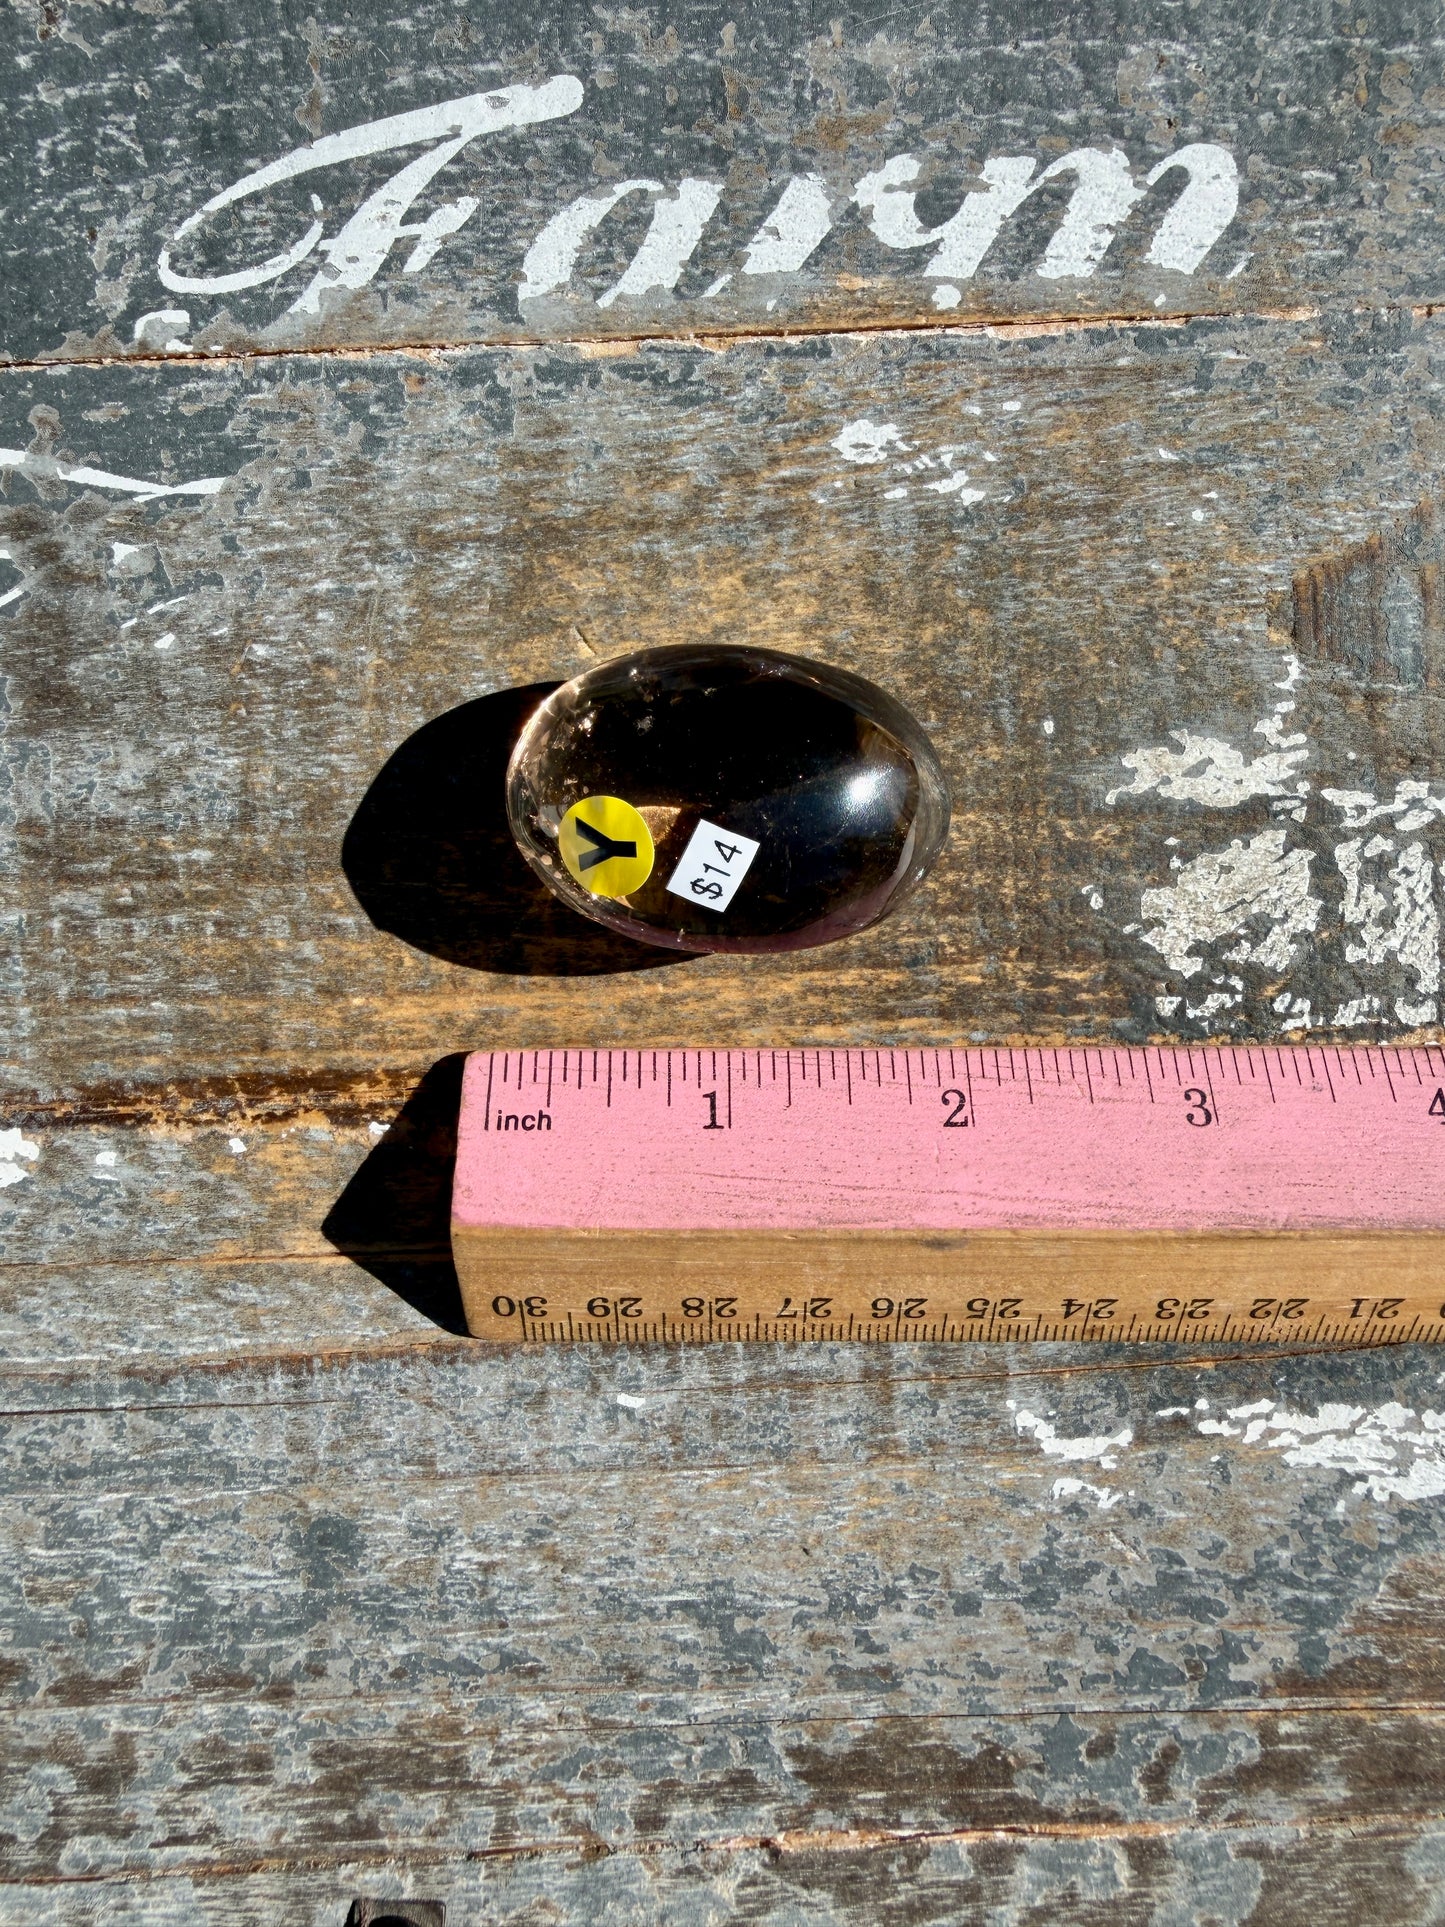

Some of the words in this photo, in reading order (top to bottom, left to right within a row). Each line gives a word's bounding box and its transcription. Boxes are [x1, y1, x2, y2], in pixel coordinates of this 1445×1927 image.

[575, 816, 637, 872] Y
[690, 839, 743, 900] $14
[496, 1109, 552, 1132] inch
[702, 1090, 724, 1130] 1
[943, 1088, 969, 1128] 2
[1184, 1088, 1212, 1127] 3
[492, 1295, 548, 1318] 30
[587, 1296, 643, 1318] 29
[682, 1297, 738, 1319] 28
[775, 1297, 834, 1319] 27
[871, 1297, 929, 1319] 26
[967, 1298, 1024, 1320] 25
[1062, 1298, 1119, 1320] 24
[1156, 1298, 1214, 1320] 23
[1249, 1298, 1310, 1320] 22
[1350, 1298, 1406, 1320] 21
